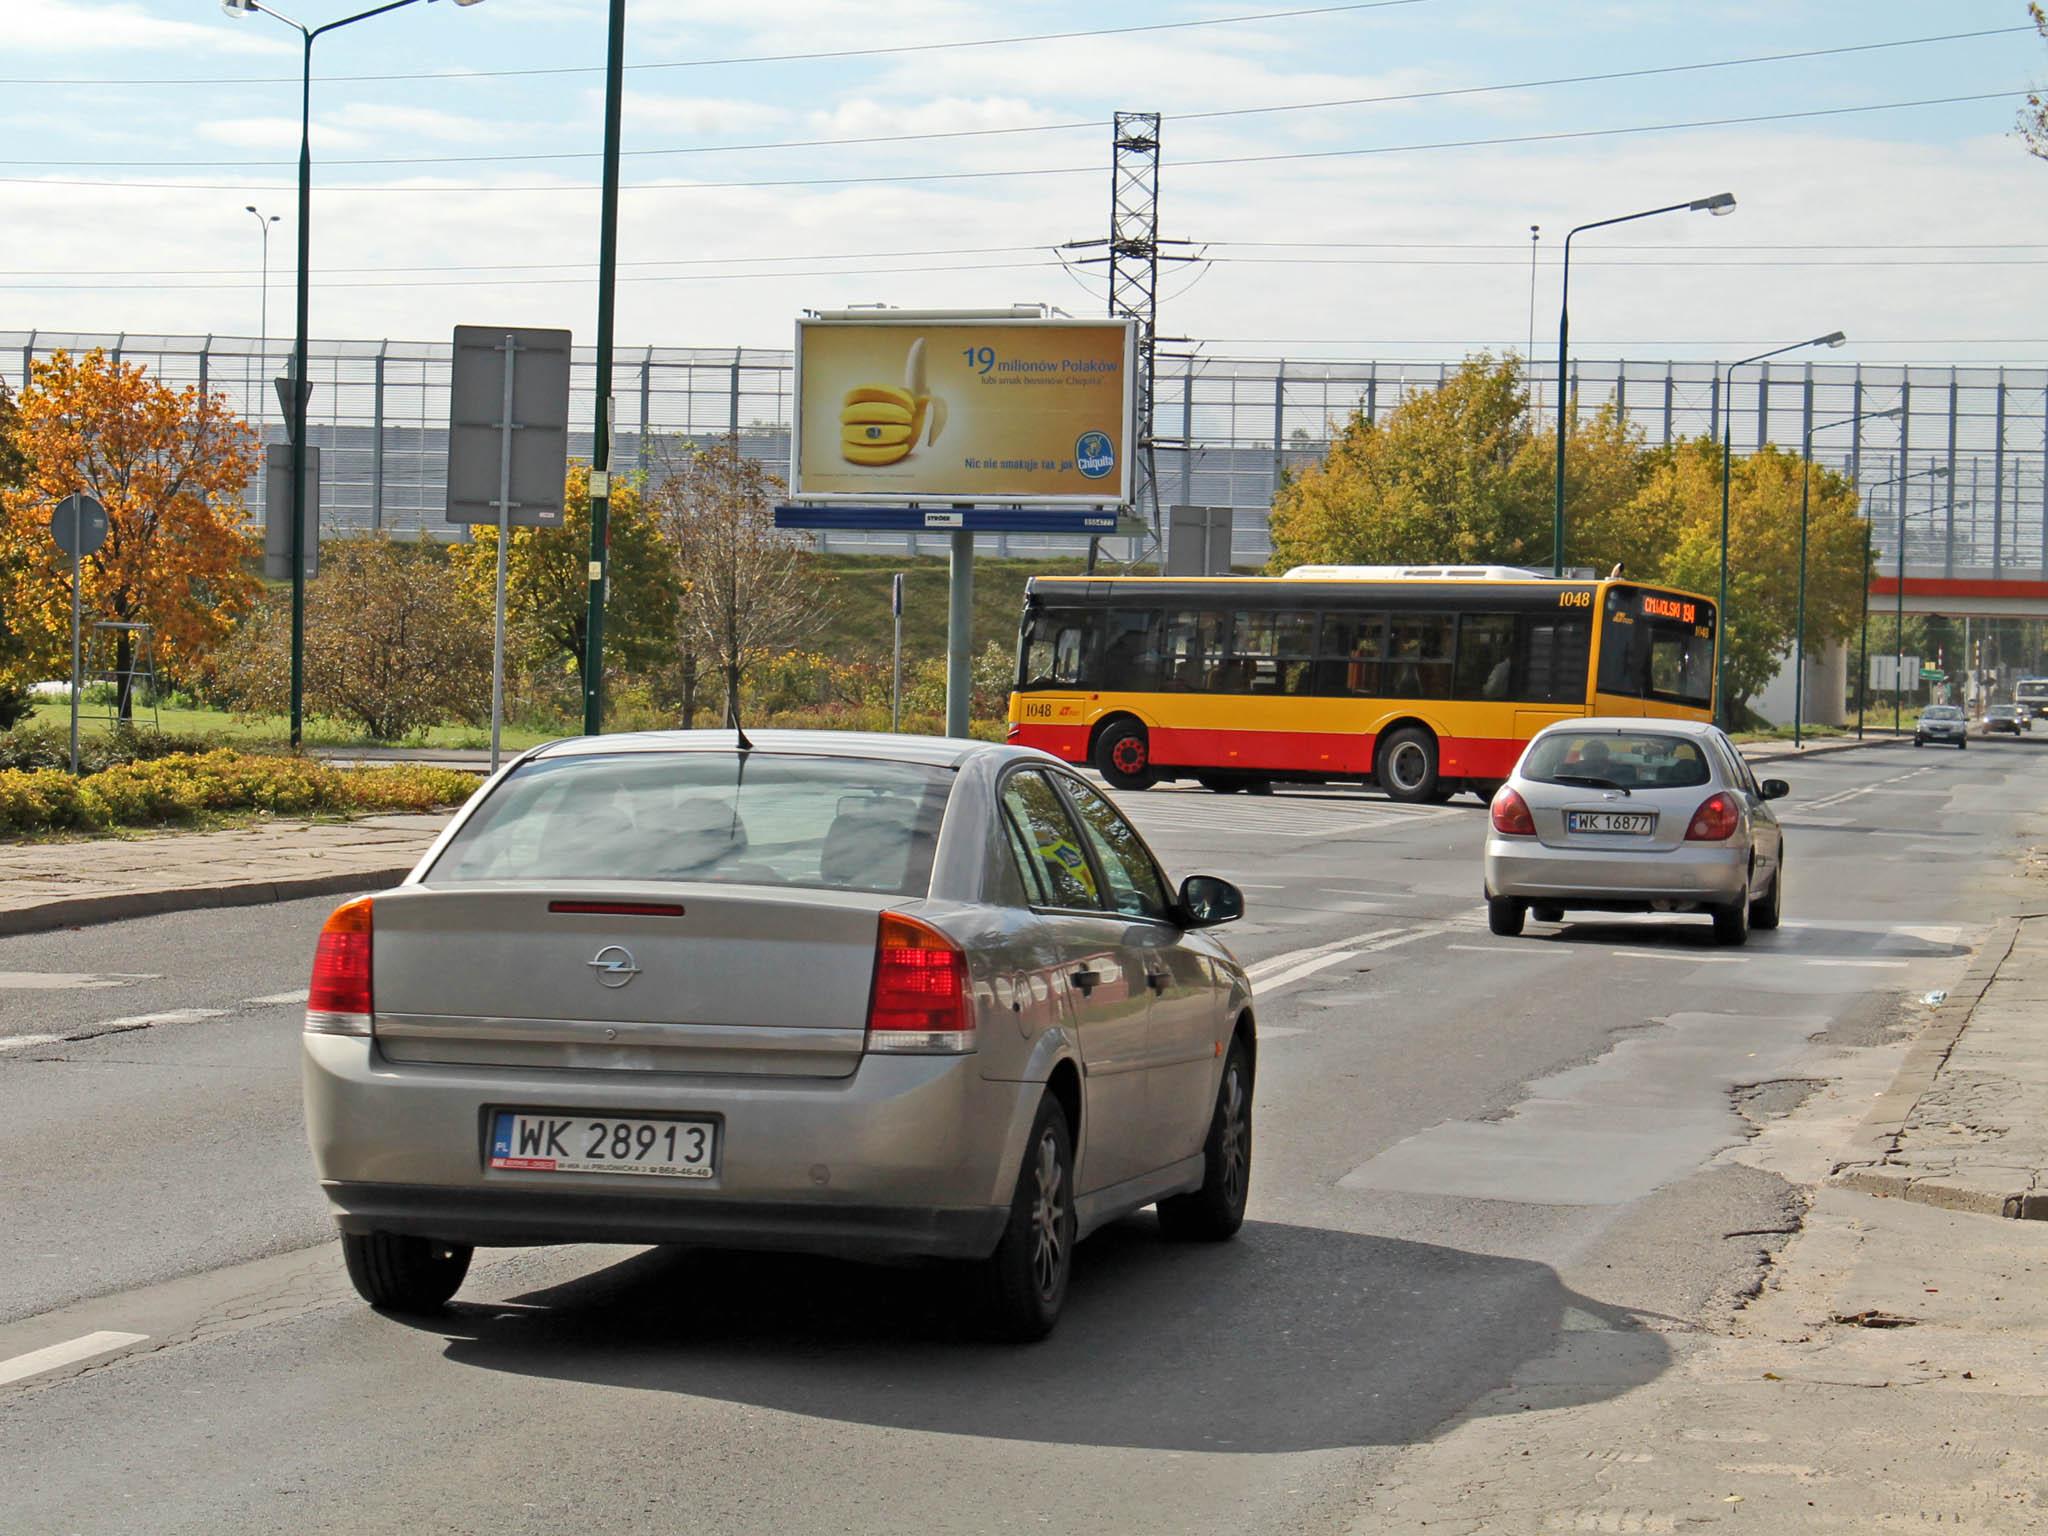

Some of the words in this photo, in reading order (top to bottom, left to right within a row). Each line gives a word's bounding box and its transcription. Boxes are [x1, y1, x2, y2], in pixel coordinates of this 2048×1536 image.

[962, 346, 995, 375] 19
[998, 359, 1057, 373] milionów
[1062, 359, 1118, 373] Polaków
[965, 457, 981, 469] Nic
[983, 458, 998, 469] nie
[1077, 456, 1114, 471] Chiquita
[1559, 591, 1591, 607] 1048
[1026, 703, 1052, 717] 1048
[1579, 815, 1599, 829] WK
[1605, 815, 1649, 831] 16877
[495, 1142, 509, 1153] PL
[519, 1119, 573, 1158] WK
[585, 1122, 706, 1164] 28913
